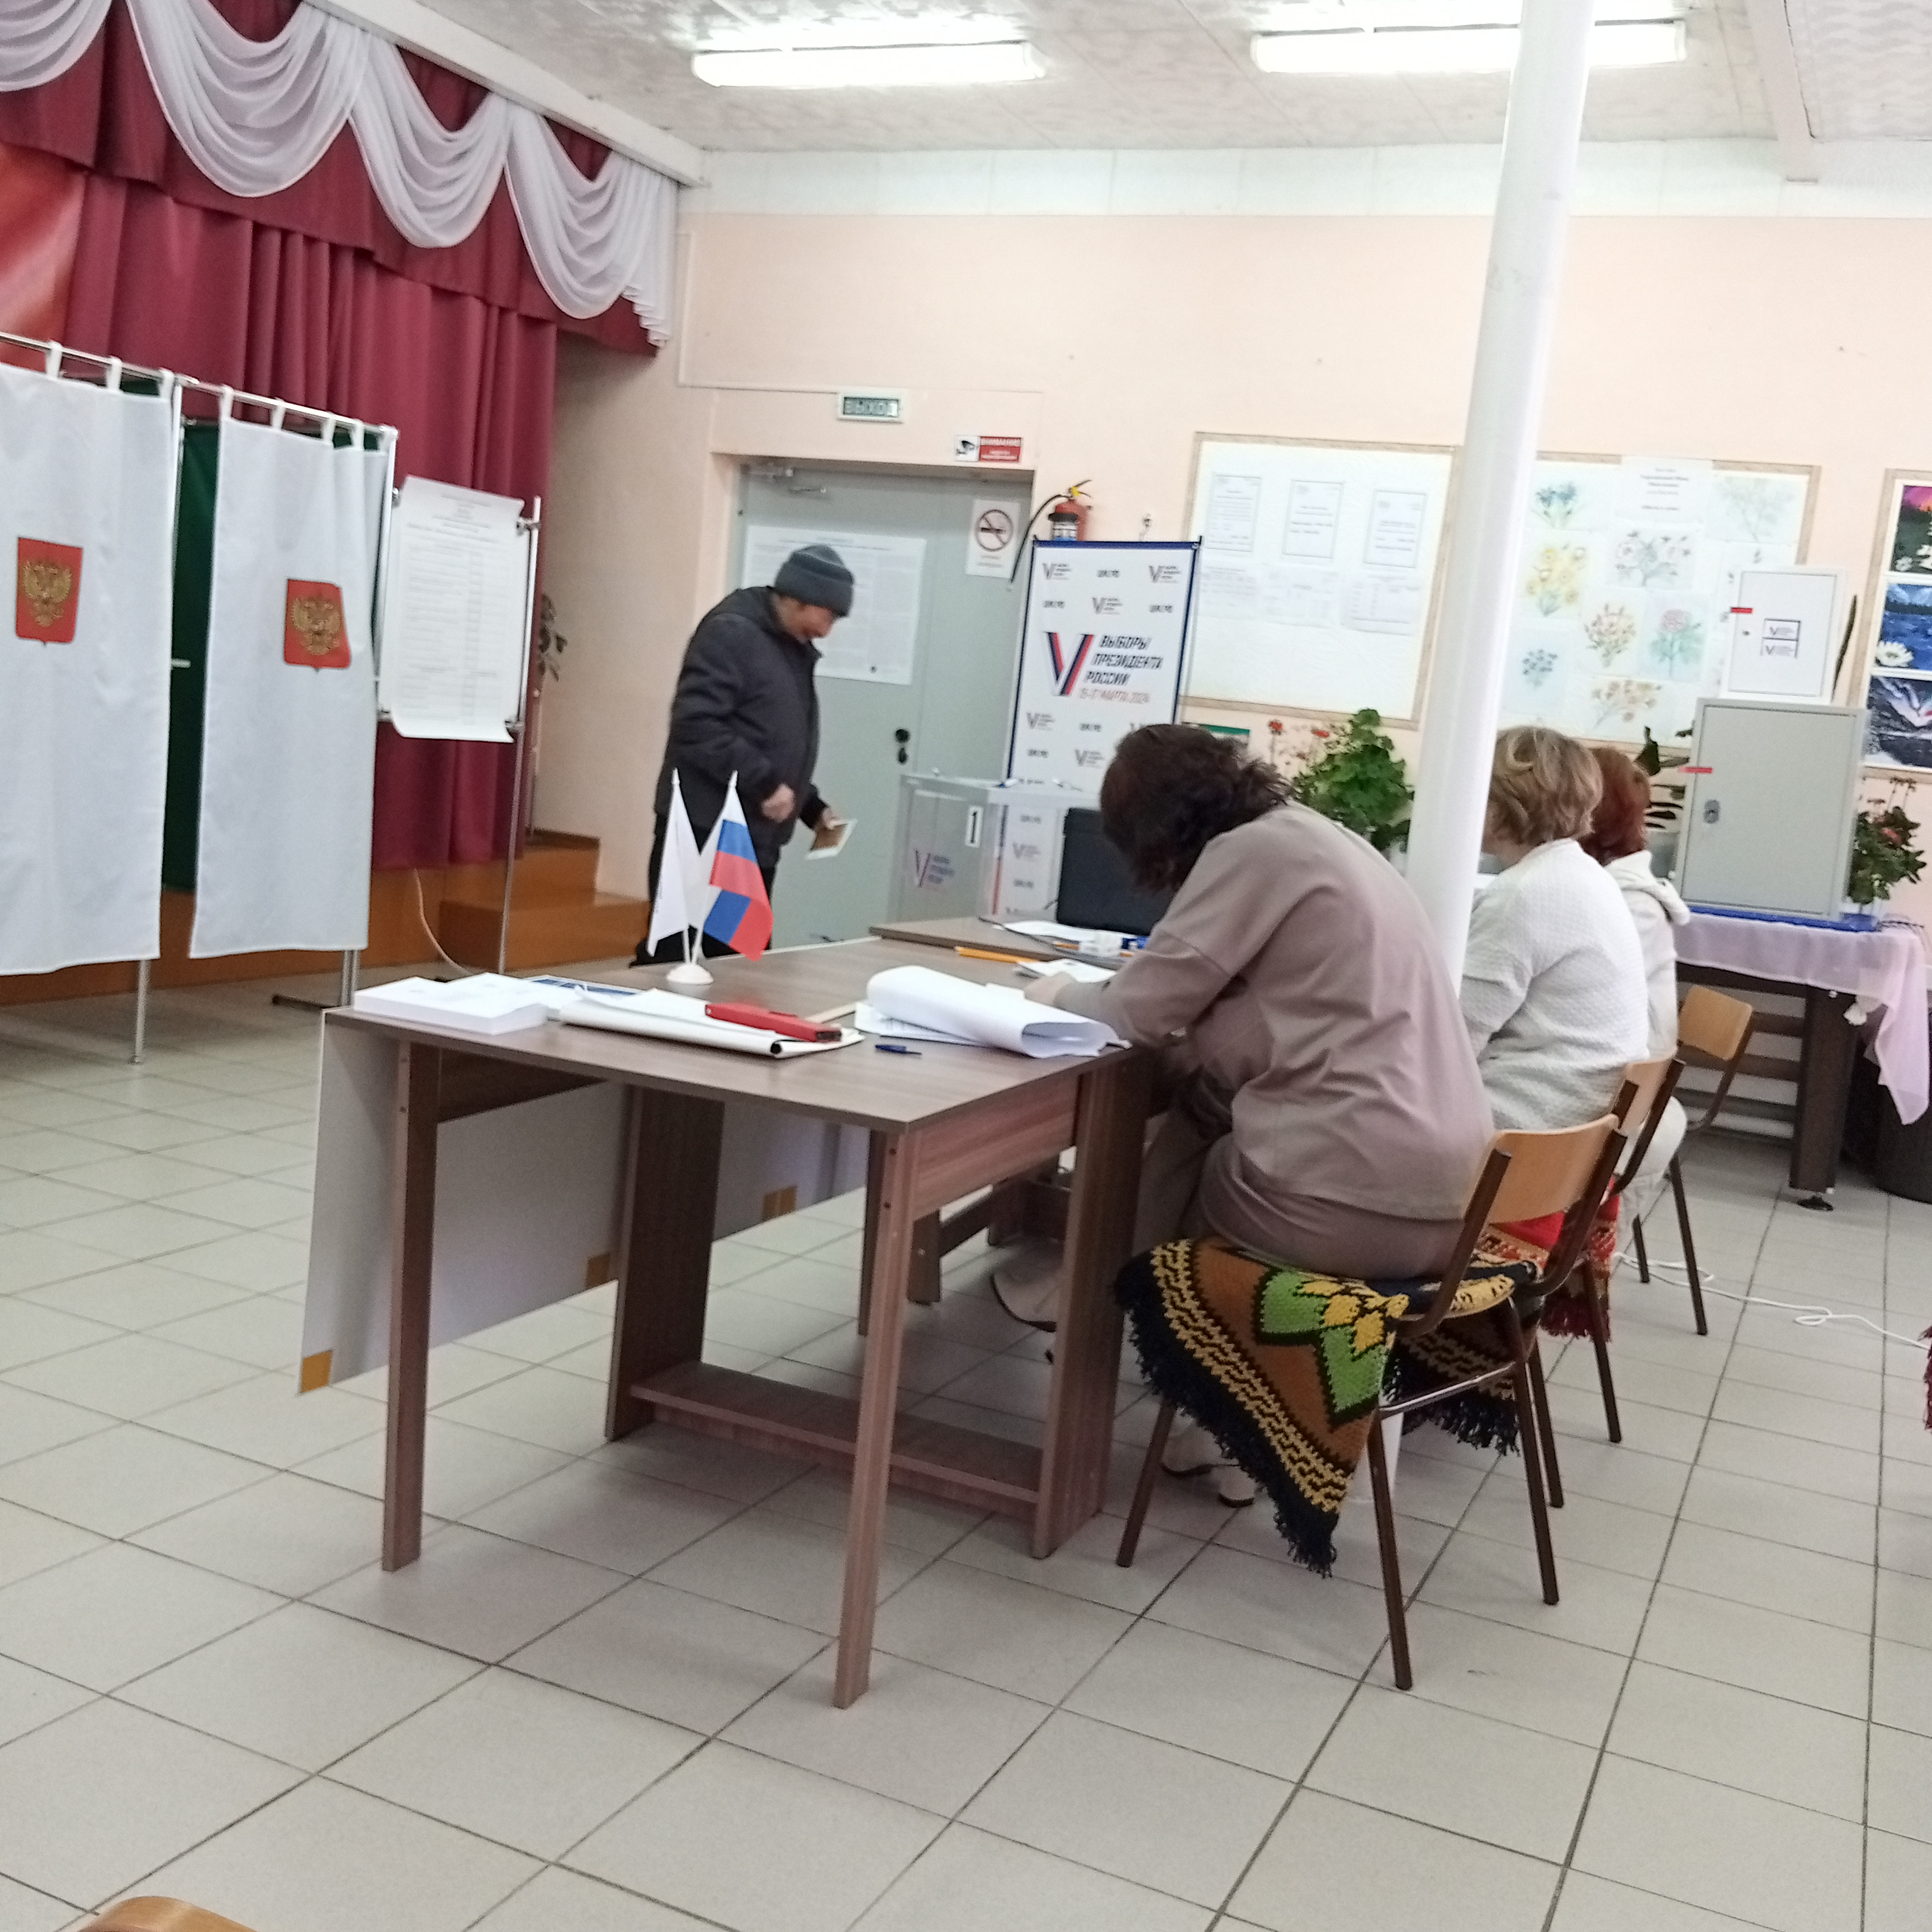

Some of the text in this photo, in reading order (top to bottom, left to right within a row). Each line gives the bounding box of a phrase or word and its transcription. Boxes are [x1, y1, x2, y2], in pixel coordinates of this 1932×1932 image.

[1100, 635, 1152, 650] ВЫБОРЫ
[1092, 654, 1163, 670] ПРЕЗИДЕНТА
[1085, 671, 1131, 685] РОССИИ
